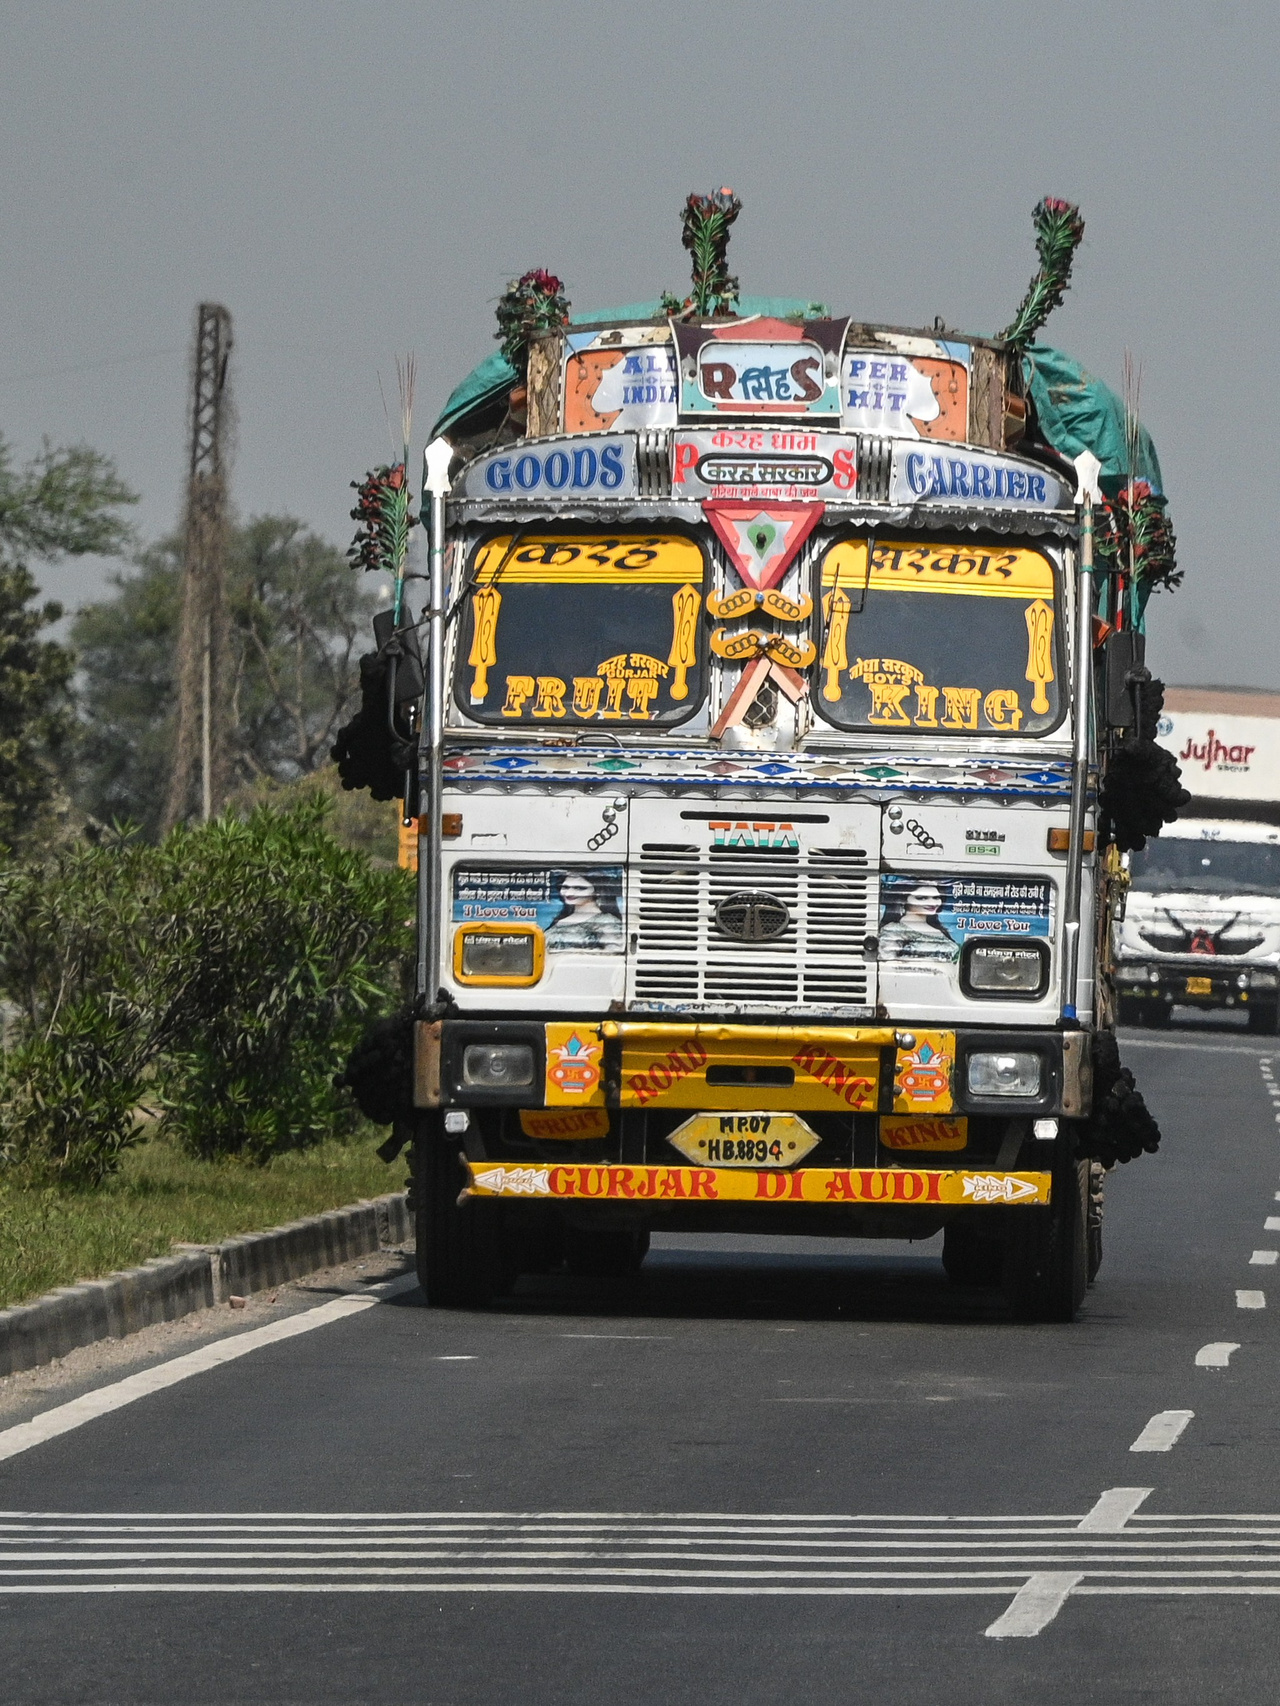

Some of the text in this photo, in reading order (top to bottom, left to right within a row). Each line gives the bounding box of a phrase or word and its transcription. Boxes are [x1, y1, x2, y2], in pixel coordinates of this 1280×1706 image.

[700, 362, 737, 400] R
[791, 356, 823, 402] S
[849, 359, 909, 381] PER
[847, 389, 907, 411] MIT
[711, 430, 819, 452] करह धाम
[484, 443, 626, 493] GOODS
[672, 442, 700, 484] P
[707, 462, 823, 481] करह सरकार
[832, 448, 858, 490] S
[905, 451, 1047, 503] CARRIER
[871, 547, 1020, 580] सरकार
[597, 653, 670, 679] करह सरकार
[607, 669, 658, 679] GURJAR
[863, 672, 912, 686] BOY'S
[881, 658, 925, 686] सरकार
[501, 675, 660, 720] FRUIT
[868, 683, 1023, 731] KING
[1179, 729, 1256, 770] Jujhar
[709, 821, 799, 847] TATA
[463, 905, 537, 918] I Love You
[957, 918, 1030, 932] I Love You
[627, 1039, 875, 1110] ROAD KING
[528, 1111, 602, 1136] FRUIT
[885, 1121, 960, 1147] KING
[550, 1166, 943, 1201] GURJAR DI AUDI
